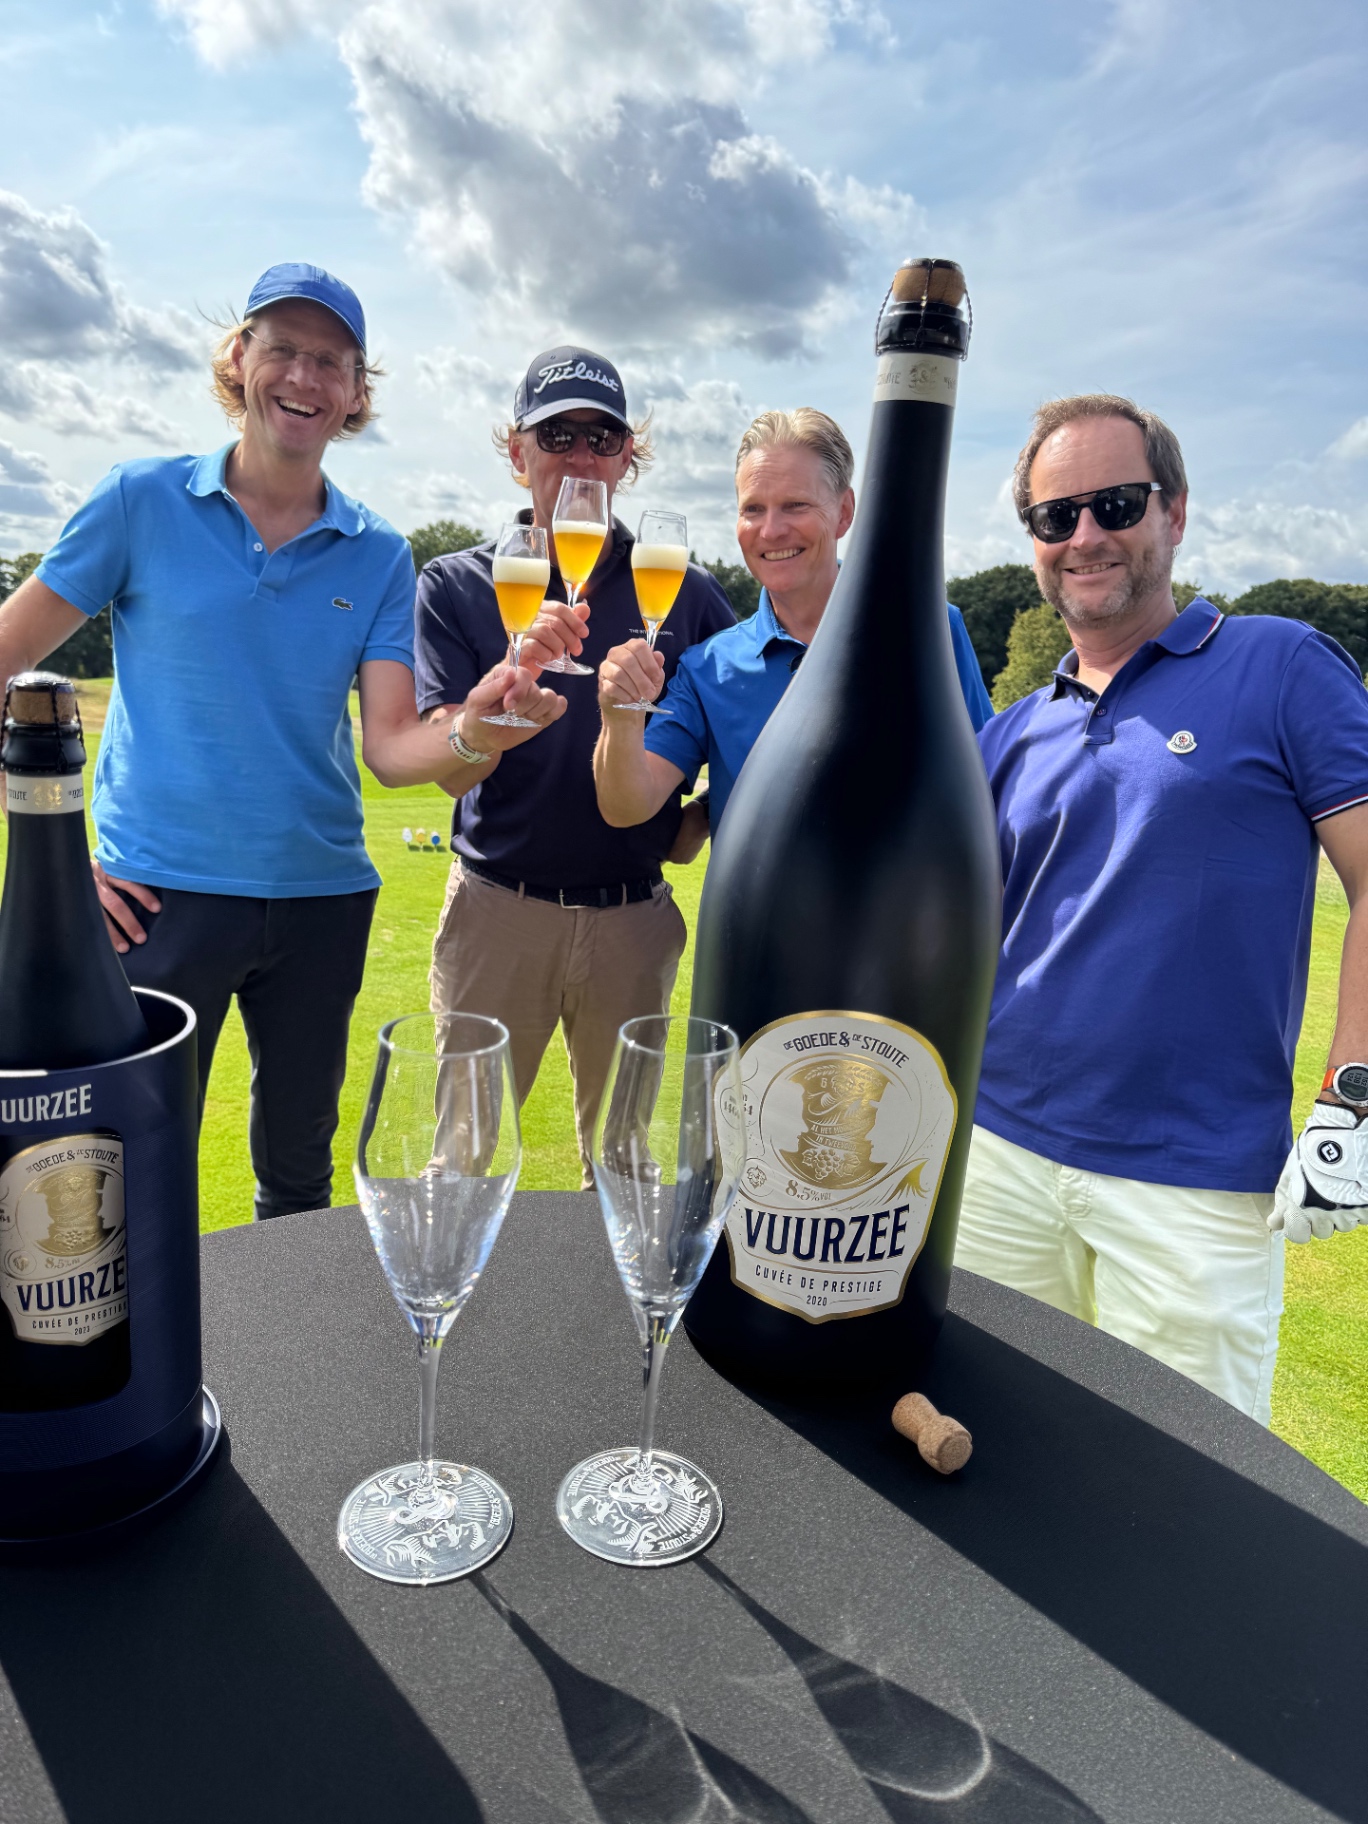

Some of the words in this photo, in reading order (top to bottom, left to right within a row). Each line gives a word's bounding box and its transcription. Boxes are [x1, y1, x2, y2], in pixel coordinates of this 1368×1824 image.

[534, 360, 618, 393] Titleist
[793, 1032, 838, 1052] GOEDE
[839, 1031, 851, 1048] &
[861, 1036, 910, 1069] STOUTE
[0, 1083, 92, 1124] UURZEE
[84, 1148, 120, 1164] STOUTE
[744, 1204, 910, 1264] VUURZEE
[16, 1254, 126, 1312] VUURZE
[755, 1264, 792, 1285] CUVÉE
[800, 1276, 815, 1290] DE
[822, 1280, 882, 1293] PRESTIGE
[806, 1295, 828, 1306] 2020
[32, 1318, 62, 1329] CUVÉE
[68, 1316, 79, 1326] DE
